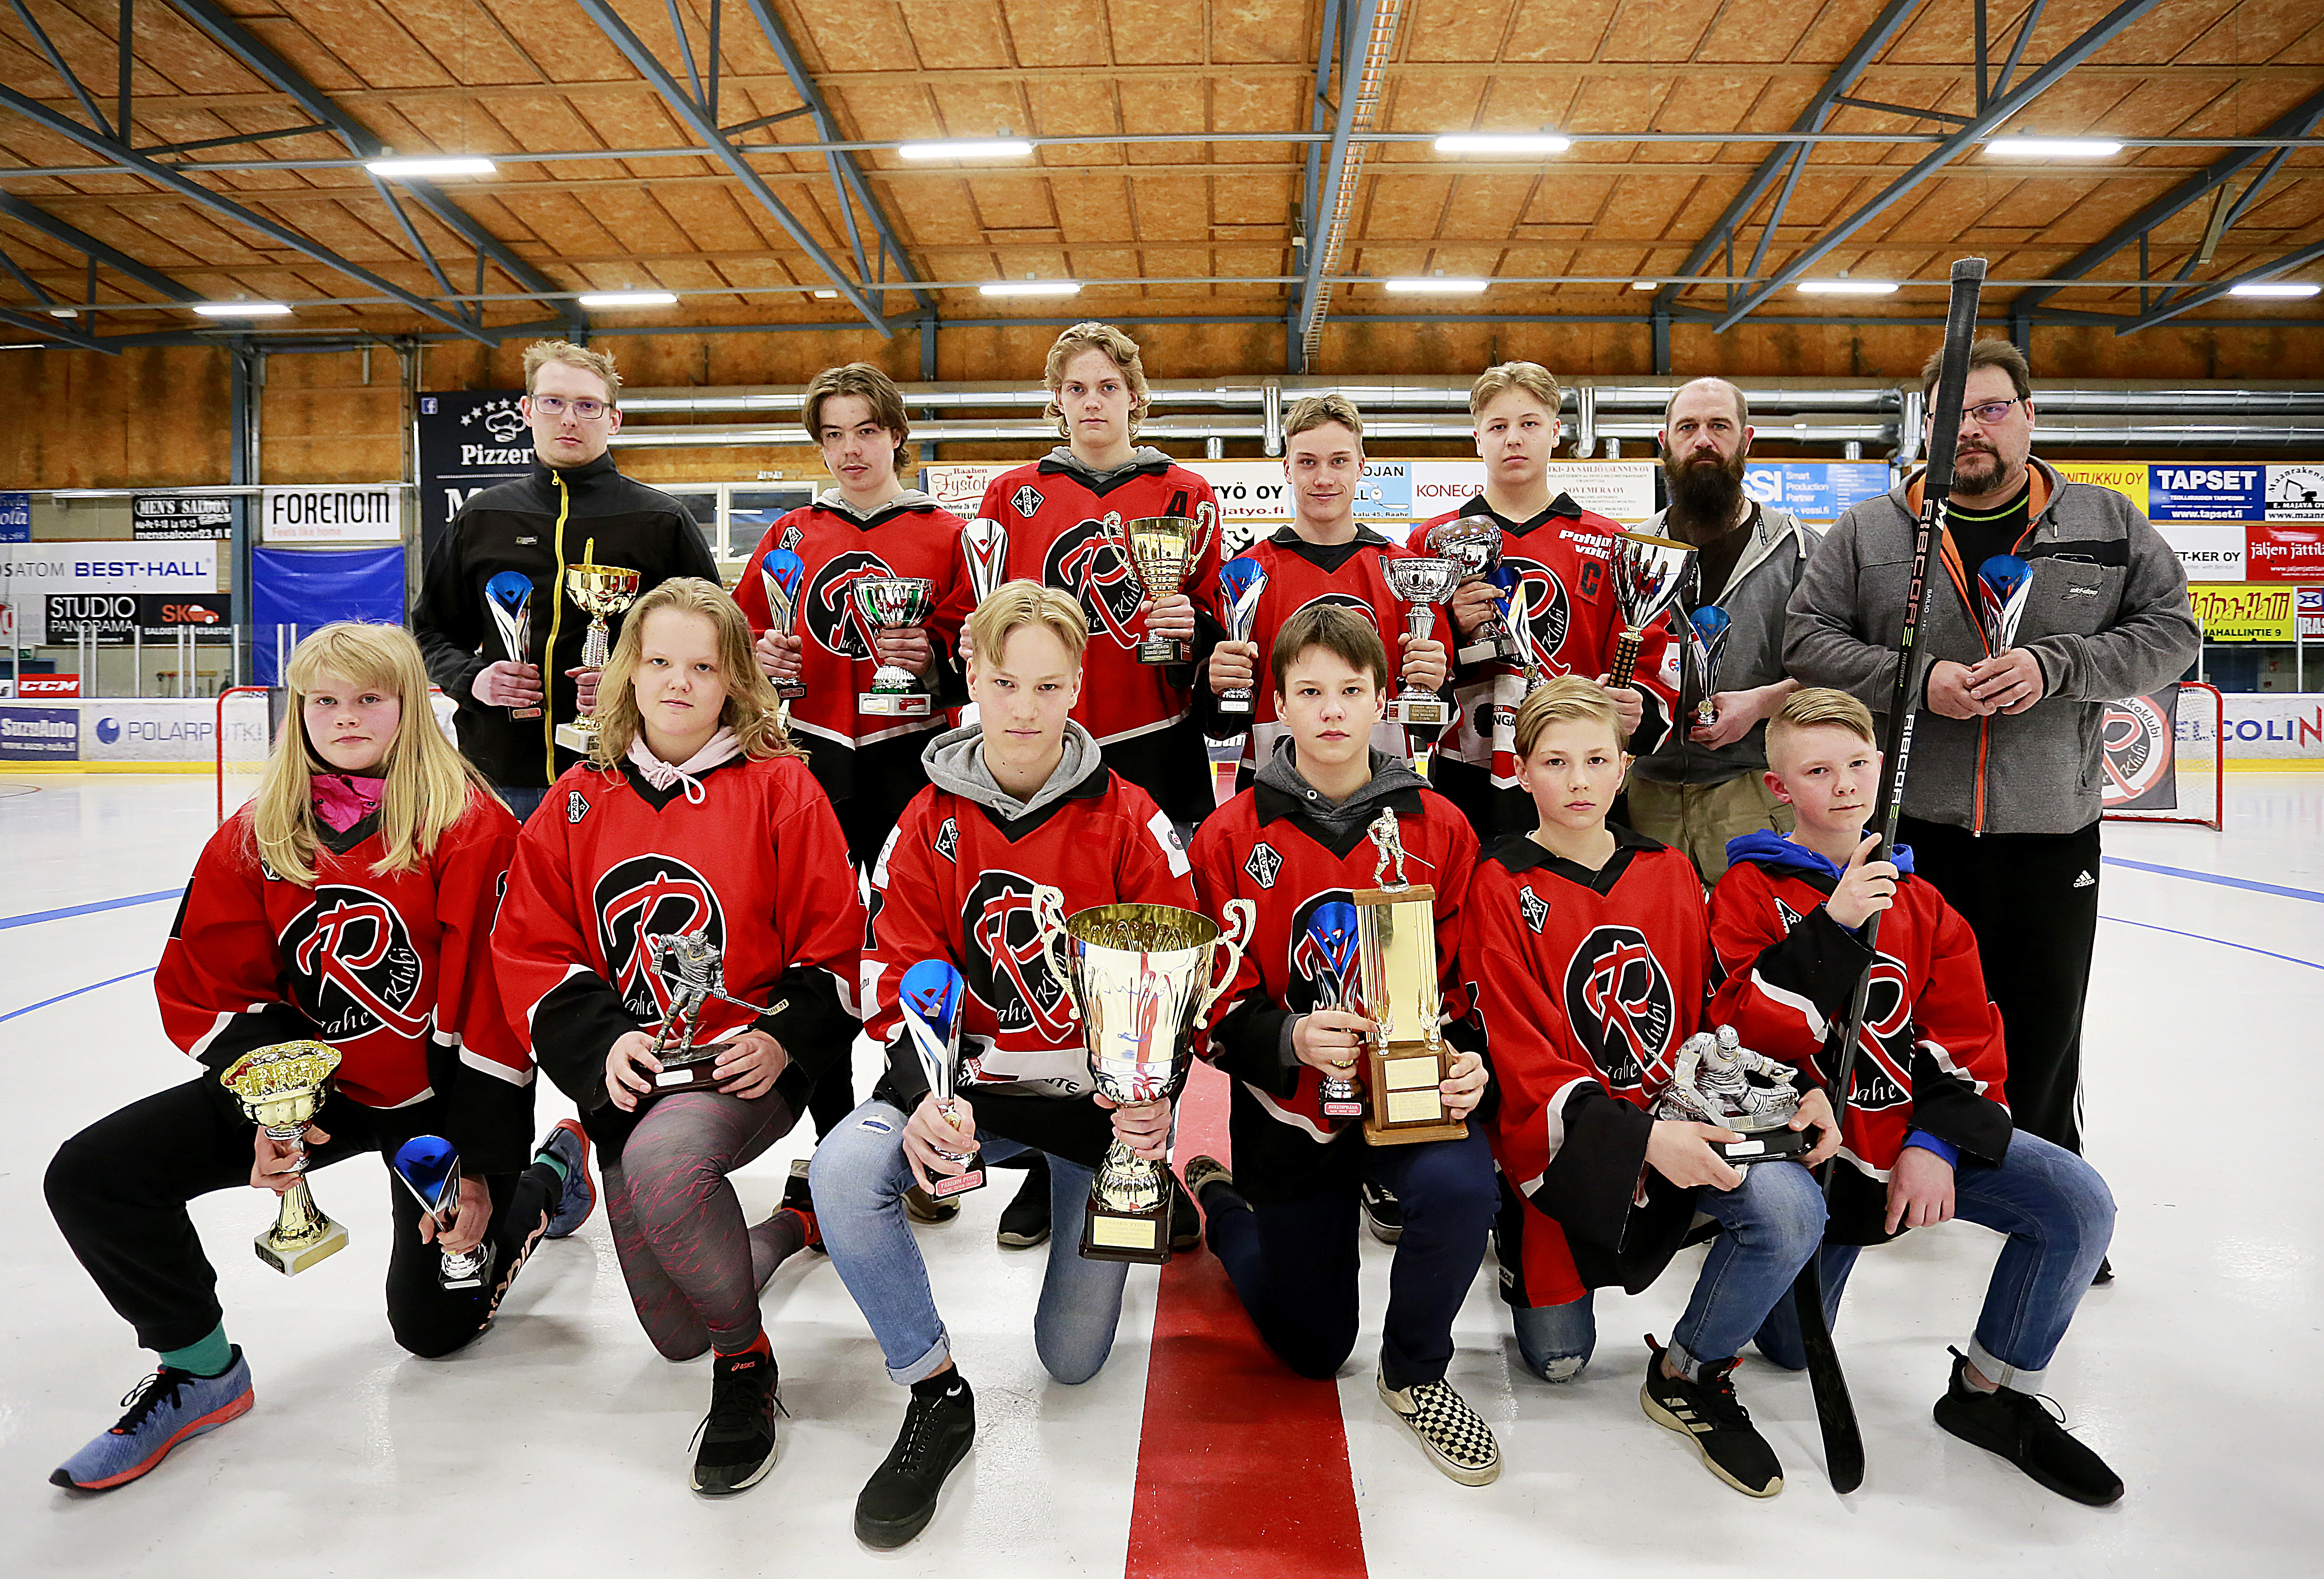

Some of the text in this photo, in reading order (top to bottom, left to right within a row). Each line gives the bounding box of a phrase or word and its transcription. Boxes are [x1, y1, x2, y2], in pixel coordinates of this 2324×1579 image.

[461, 444, 534, 465] Pizzer
[2126, 472, 2143, 485] OY
[2157, 470, 2257, 490] TAPSET
[1023, 487, 1032, 516] TACKLA
[1256, 485, 1283, 499] OY
[181, 499, 230, 514] SALOON
[274, 492, 389, 524] FORENOM
[1164, 490, 1188, 517] A
[2171, 510, 2243, 519] www.tapset.fi
[1559, 529, 1613, 547] Pohjo
[2223, 552, 2241, 562] OY
[2251, 542, 2287, 559] jäljen
[0, 562, 207, 577] SATOM BEST-HALL
[1581, 562, 1602, 596] C
[50, 596, 136, 618] STUDIO
[1924, 588, 1933, 614] SAILIO
[1542, 607, 1564, 649] Klubi
[20, 680, 79, 691] CCM
[1891, 713, 1915, 805] RIBCOR
[1257, 845, 1272, 886] TACKLA
[384, 947, 416, 1003] Klubi
[322, 1006, 370, 1034] ahe
